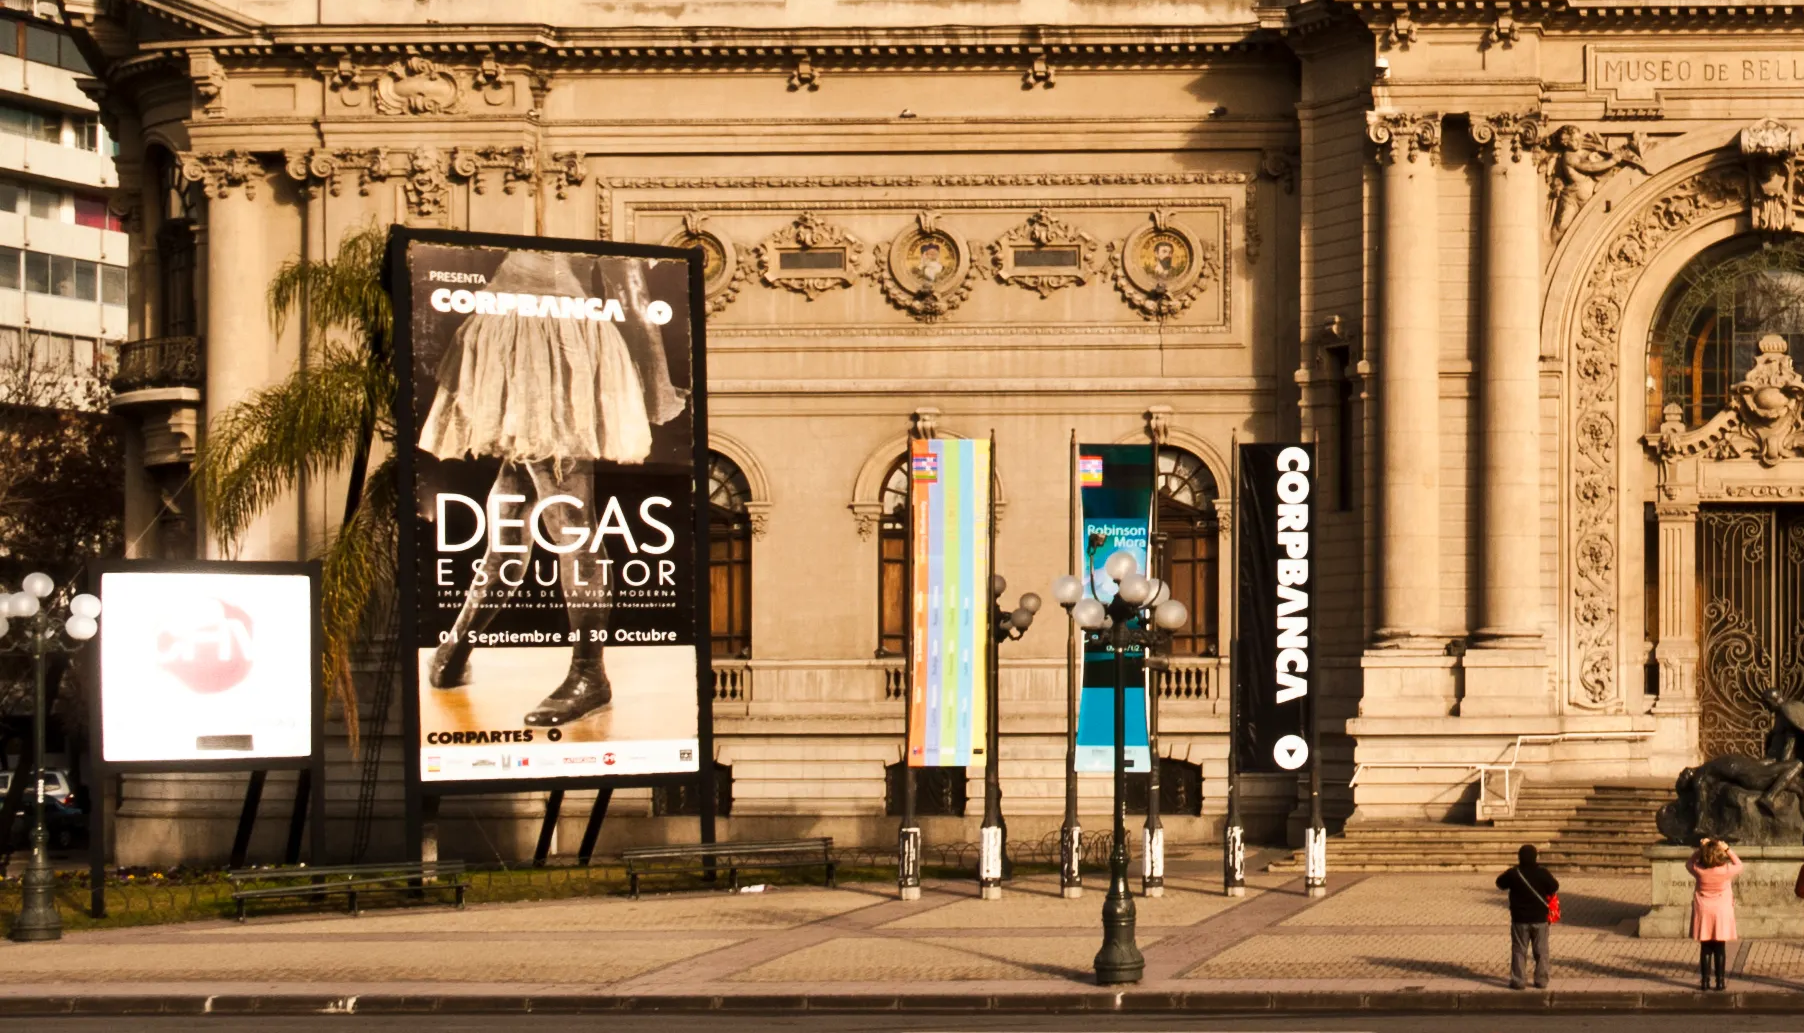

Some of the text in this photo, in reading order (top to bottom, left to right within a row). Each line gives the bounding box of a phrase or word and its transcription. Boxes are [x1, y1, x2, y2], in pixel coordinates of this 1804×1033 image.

[1605, 59, 1691, 82] MUSEO
[1705, 63, 1729, 81] DE
[429, 270, 487, 285] PRESENTA
[430, 288, 626, 322] CORPBANCA
[436, 493, 676, 555] DEGAS
[1087, 524, 1146, 536] Robinson
[1114, 536, 1146, 547] Mora
[437, 558, 676, 586] ESCULTOR
[1276, 446, 1310, 704] CORPBANCA
[439, 628, 677, 645] 01 Septiembre al 30 Octubre
[427, 729, 533, 744] CORPARTES
